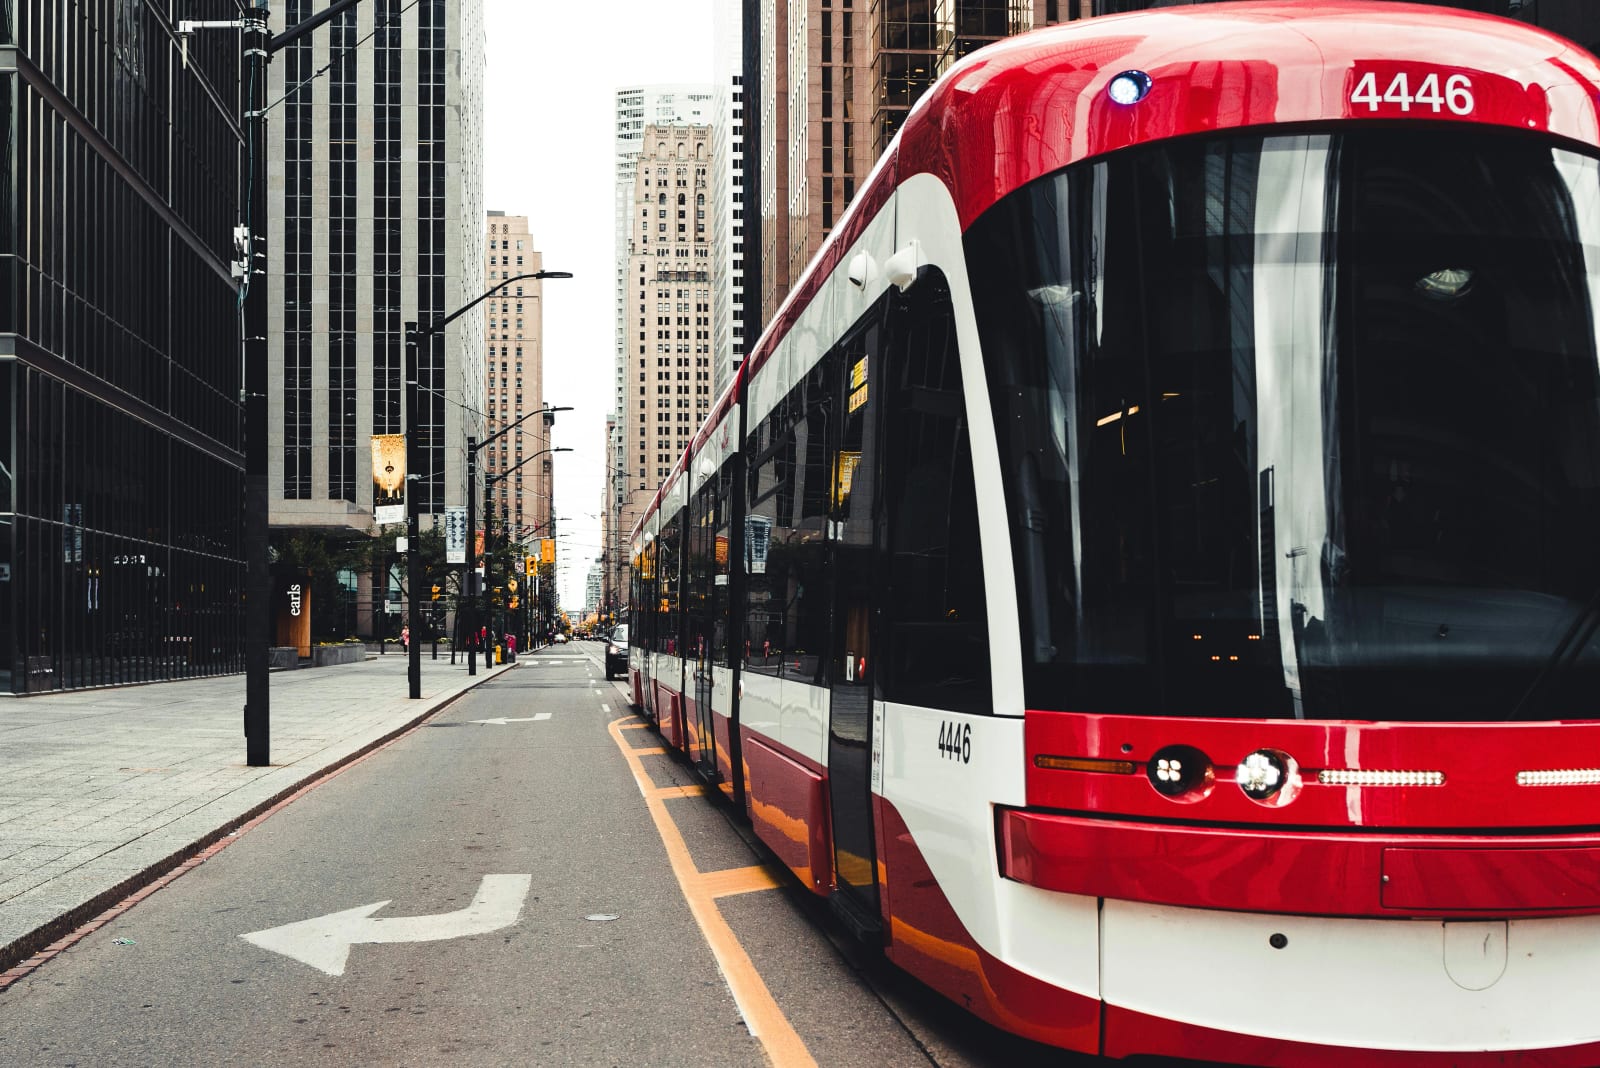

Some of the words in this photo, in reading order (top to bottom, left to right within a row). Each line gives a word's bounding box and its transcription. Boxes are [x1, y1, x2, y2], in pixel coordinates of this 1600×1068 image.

[1350, 71, 1475, 116] 4446
[286, 584, 301, 616] earls
[938, 720, 972, 764] 4446
